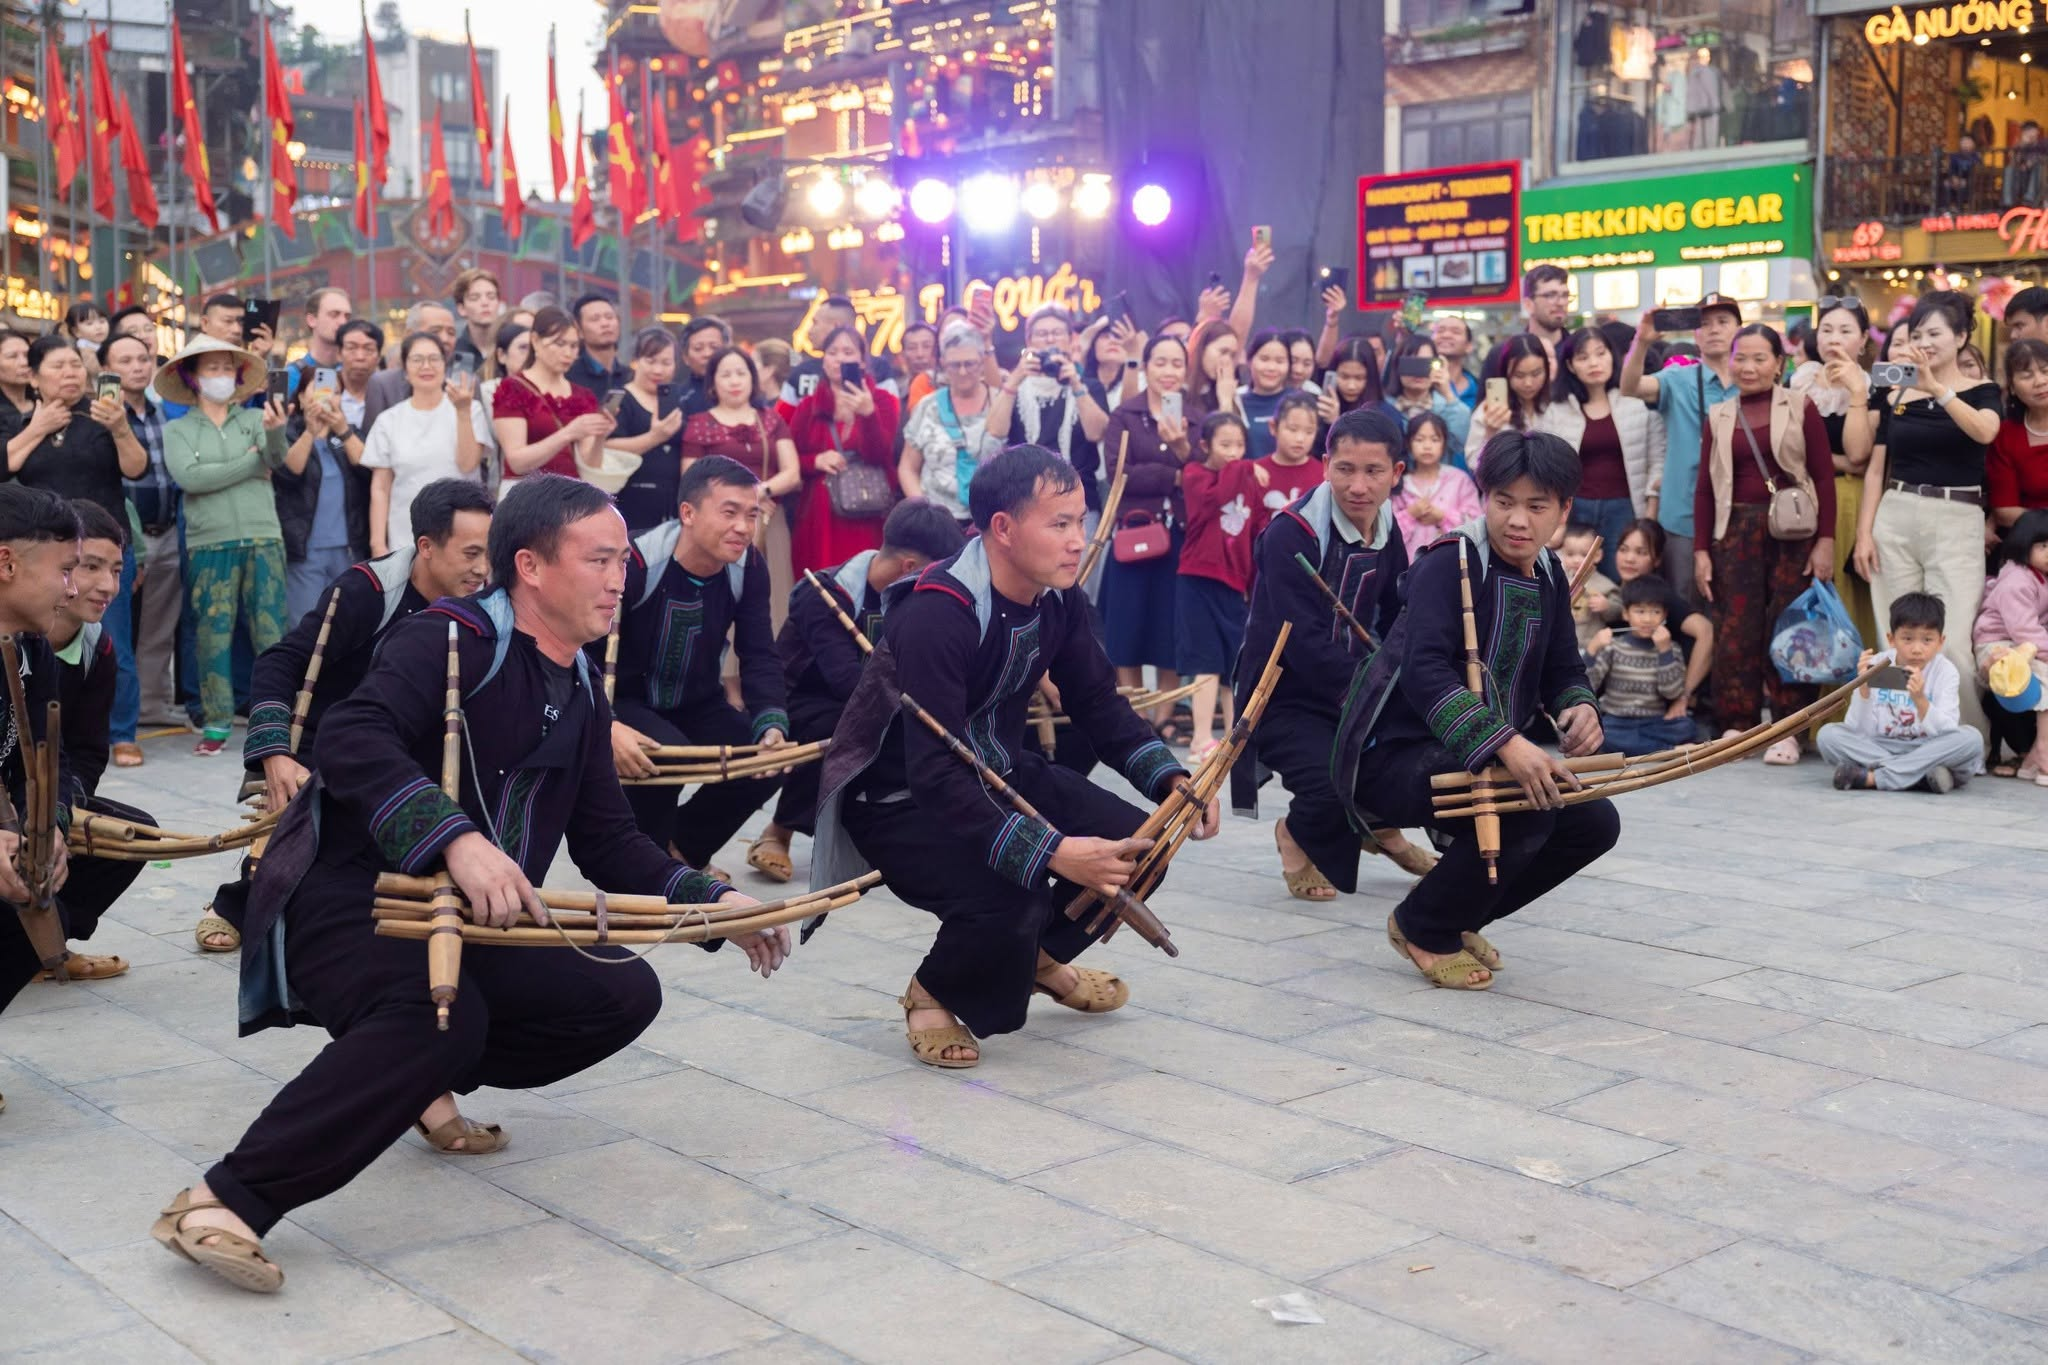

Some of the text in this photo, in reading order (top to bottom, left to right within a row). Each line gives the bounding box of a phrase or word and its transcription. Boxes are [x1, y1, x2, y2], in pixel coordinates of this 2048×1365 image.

[1865, 5, 1912, 45] GÀ
[1524, 193, 1783, 244] TREKKING GEAR
[1852, 221, 1885, 247] 69
